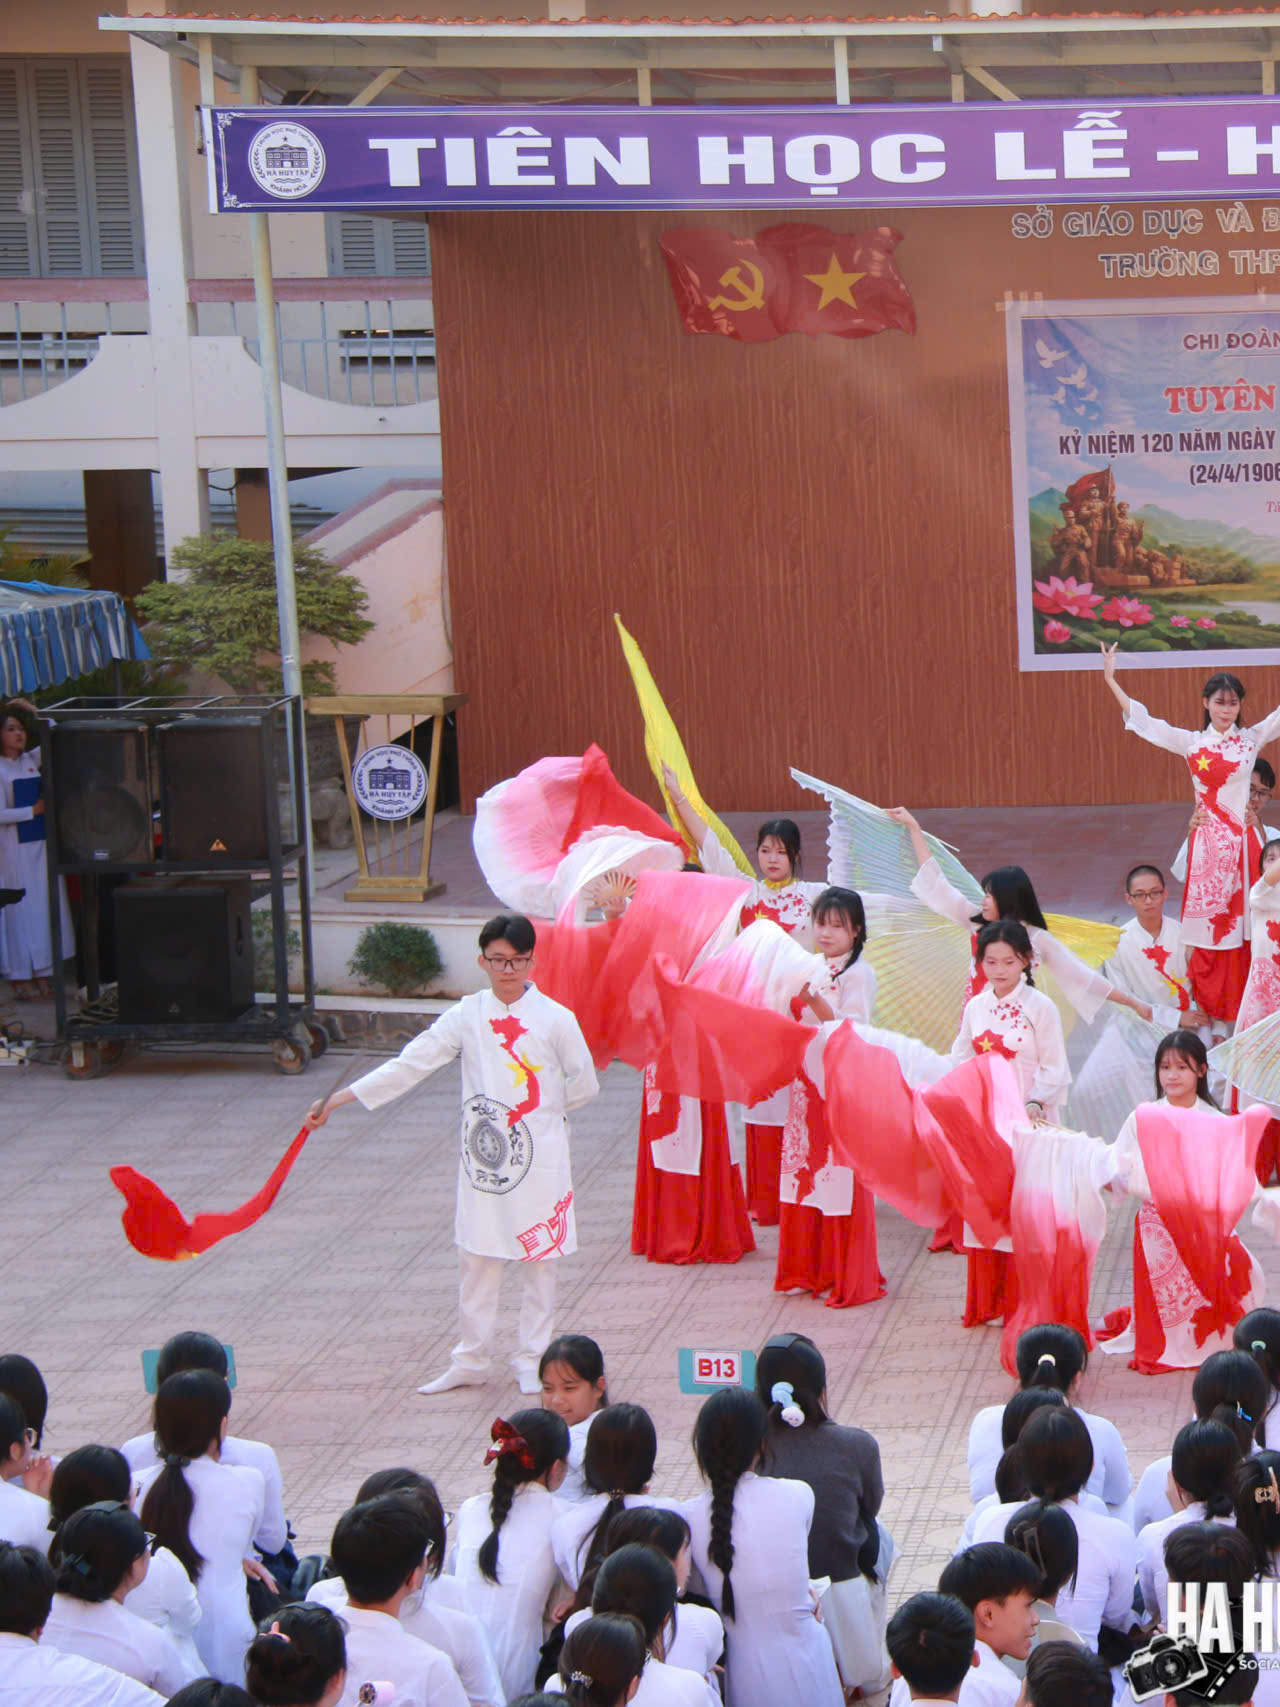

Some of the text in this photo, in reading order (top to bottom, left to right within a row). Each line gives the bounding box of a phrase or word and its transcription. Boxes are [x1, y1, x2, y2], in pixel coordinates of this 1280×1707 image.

[368, 126, 651, 186] TIÊN
[698, 133, 947, 195] HỌC
[995, 110, 1131, 181] LỄ
[1011, 204, 1054, 239] SỞ
[1063, 205, 1135, 238] GIÁO
[1143, 208, 1203, 239] DỤC
[1216, 201, 1254, 233] VÀ
[1098, 246, 1220, 278] TRƯỜNG
[1183, 334, 1219, 350] CHI
[1164, 378, 1276, 414] TUYÊN
[1059, 429, 1082, 455] KỶ
[1088, 431, 1135, 458] NIỆM
[1141, 433, 1173, 453] 120
[1179, 428, 1221, 452] NĂM
[1228, 427, 1275, 450] NGÀY
[698, 1358, 736, 1378] B13
